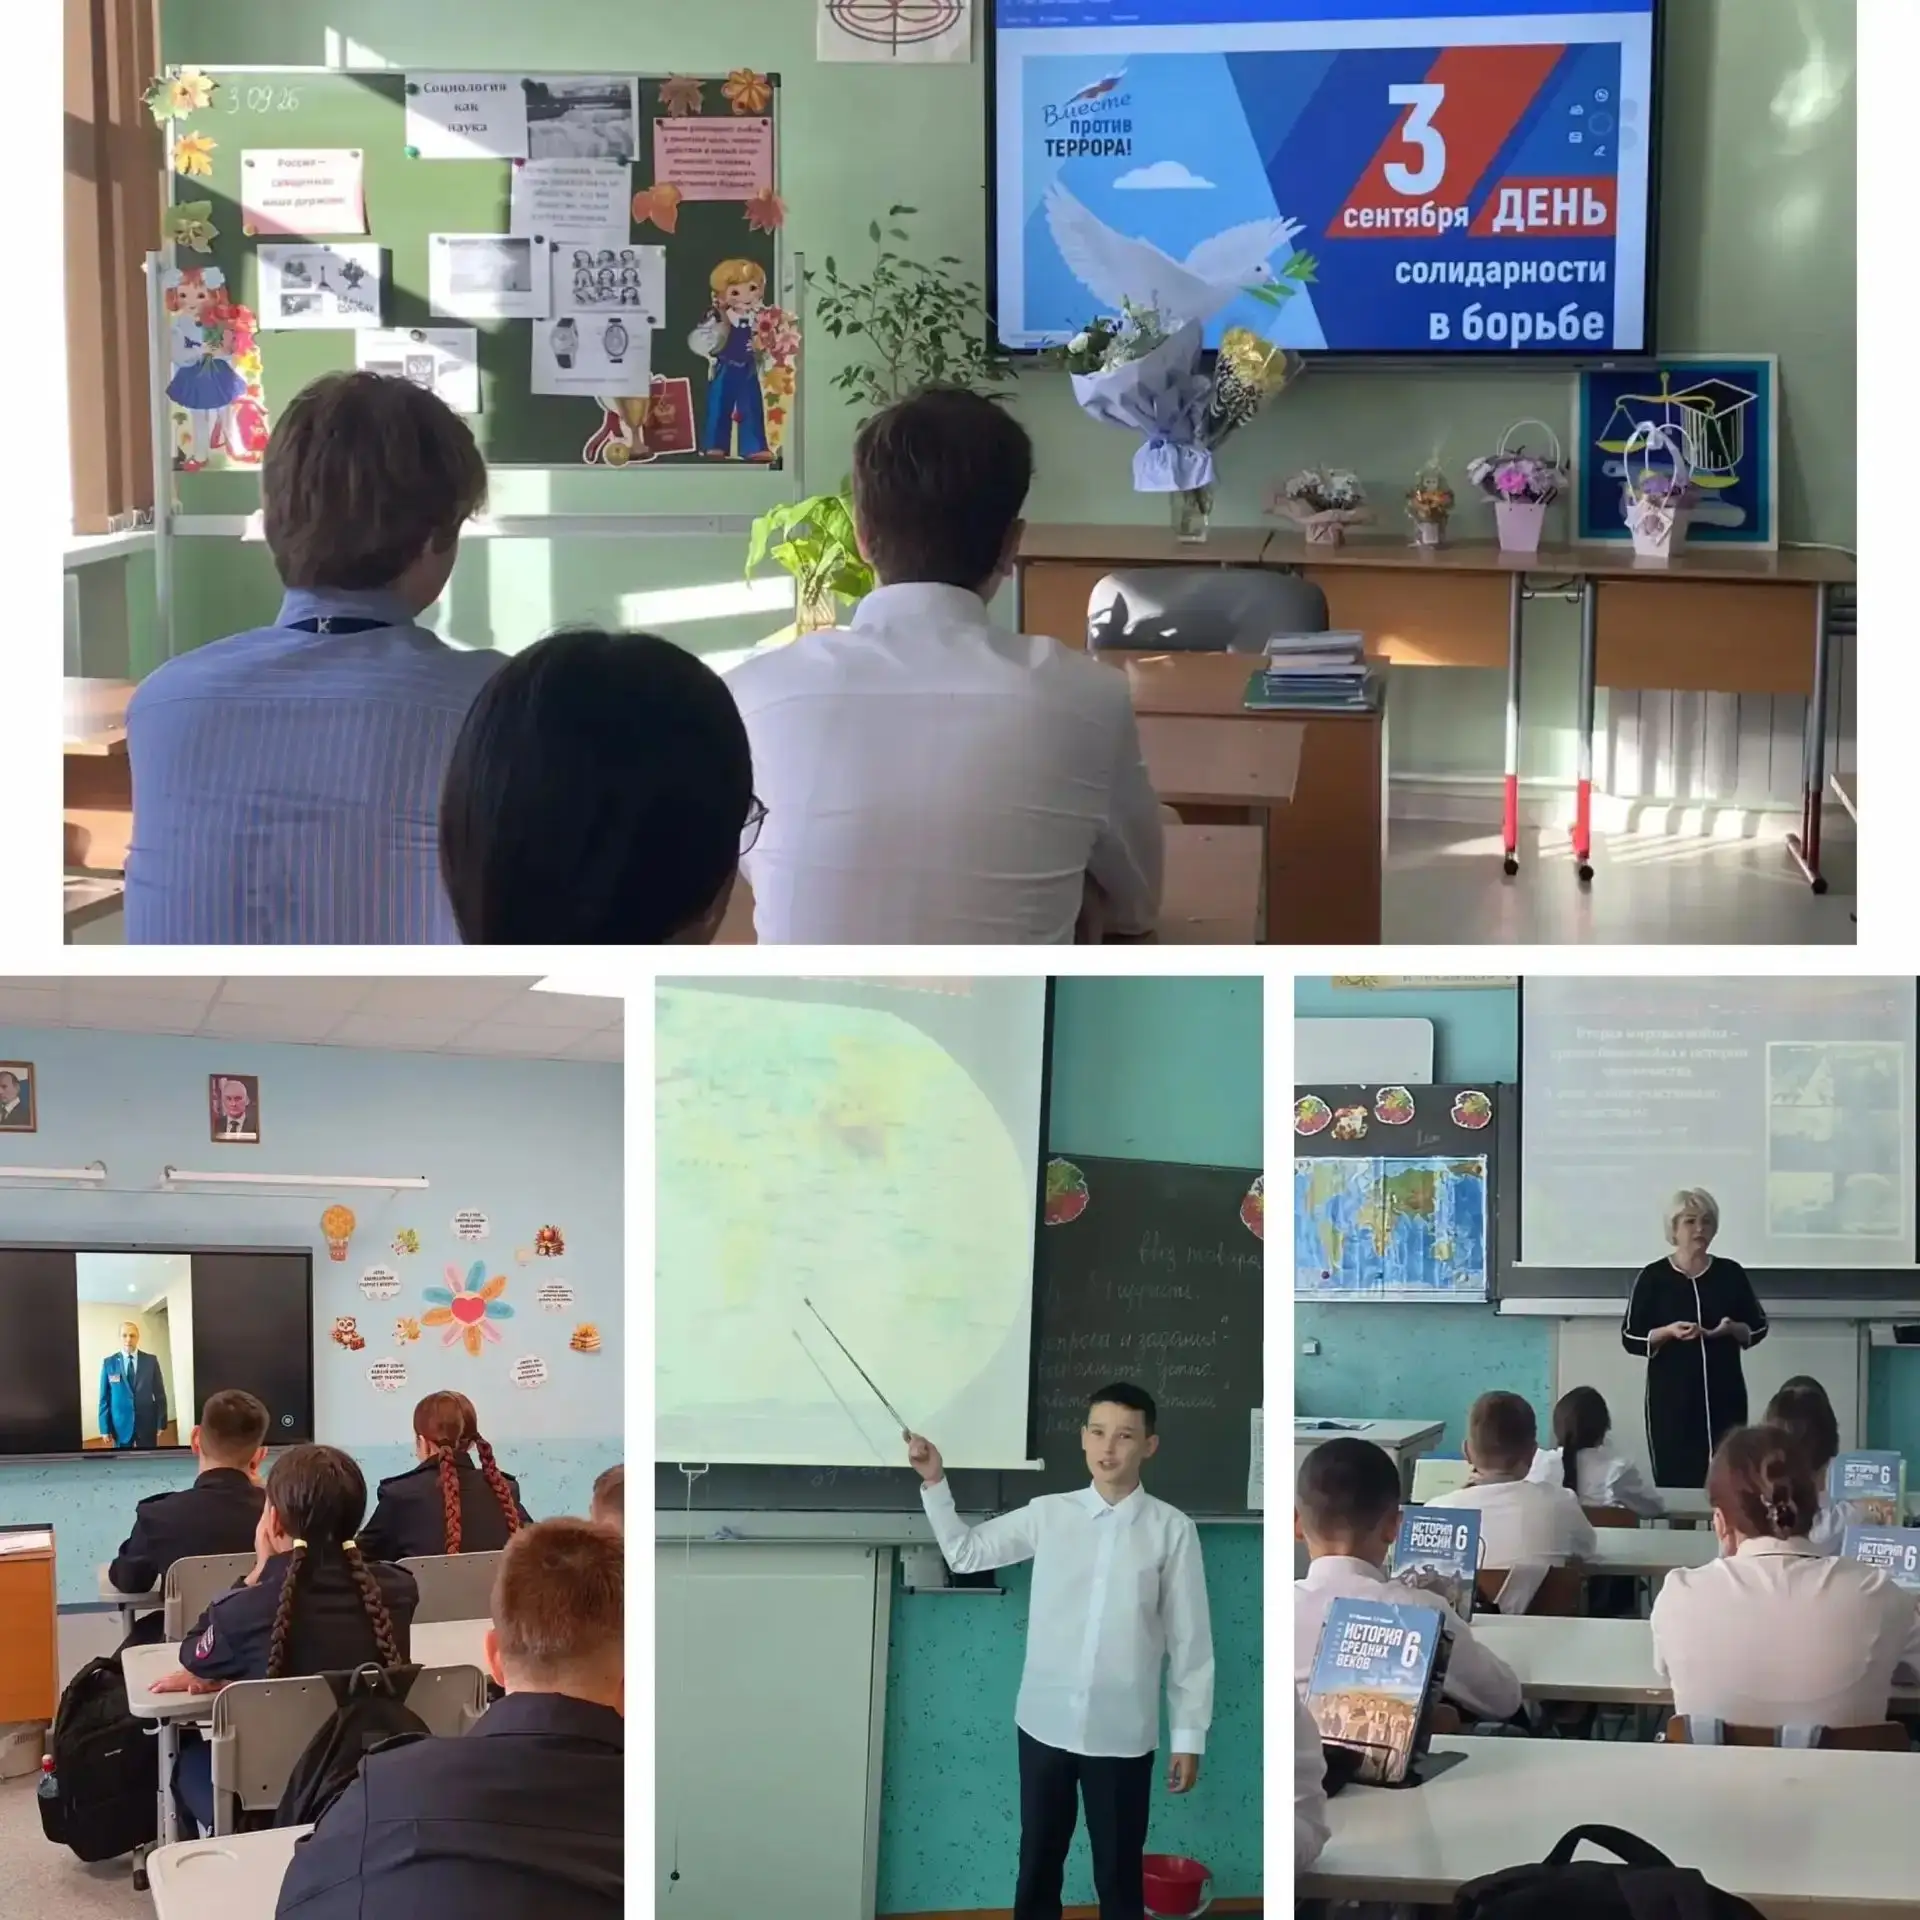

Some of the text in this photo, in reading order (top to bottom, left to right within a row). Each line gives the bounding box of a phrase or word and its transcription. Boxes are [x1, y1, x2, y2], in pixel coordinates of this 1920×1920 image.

[423, 82, 507, 95] Социология
[454, 103, 479, 112] как
[1042, 93, 1132, 128] Вместе
[448, 123, 488, 135] наука
[1070, 119, 1132, 137] против
[1044, 138, 1131, 157] ТЕРРОРА!
[1383, 83, 1446, 195] 3
[1343, 201, 1469, 234] сентября
[1492, 187, 1607, 233] ДЕНЬ
[1395, 260, 1607, 289] солидарности
[1429, 302, 1605, 349] в борьбе
[1881, 1465, 1891, 1485] 6
[1412, 1521, 1453, 1536] ИСТОРИЯ
[1455, 1524, 1468, 1551] 6
[1410, 1533, 1453, 1549] РОССИИ
[1859, 1542, 1904, 1557] ИСТОРИЯ
[1904, 1545, 1918, 1572] 6
[1344, 1621, 1404, 1647] ИСТОРИЯ
[1340, 1640, 1390, 1659] СРЕДНИХ
[1401, 1630, 1421, 1668] 6
[1336, 1653, 1372, 1670] ВЕКОВ
